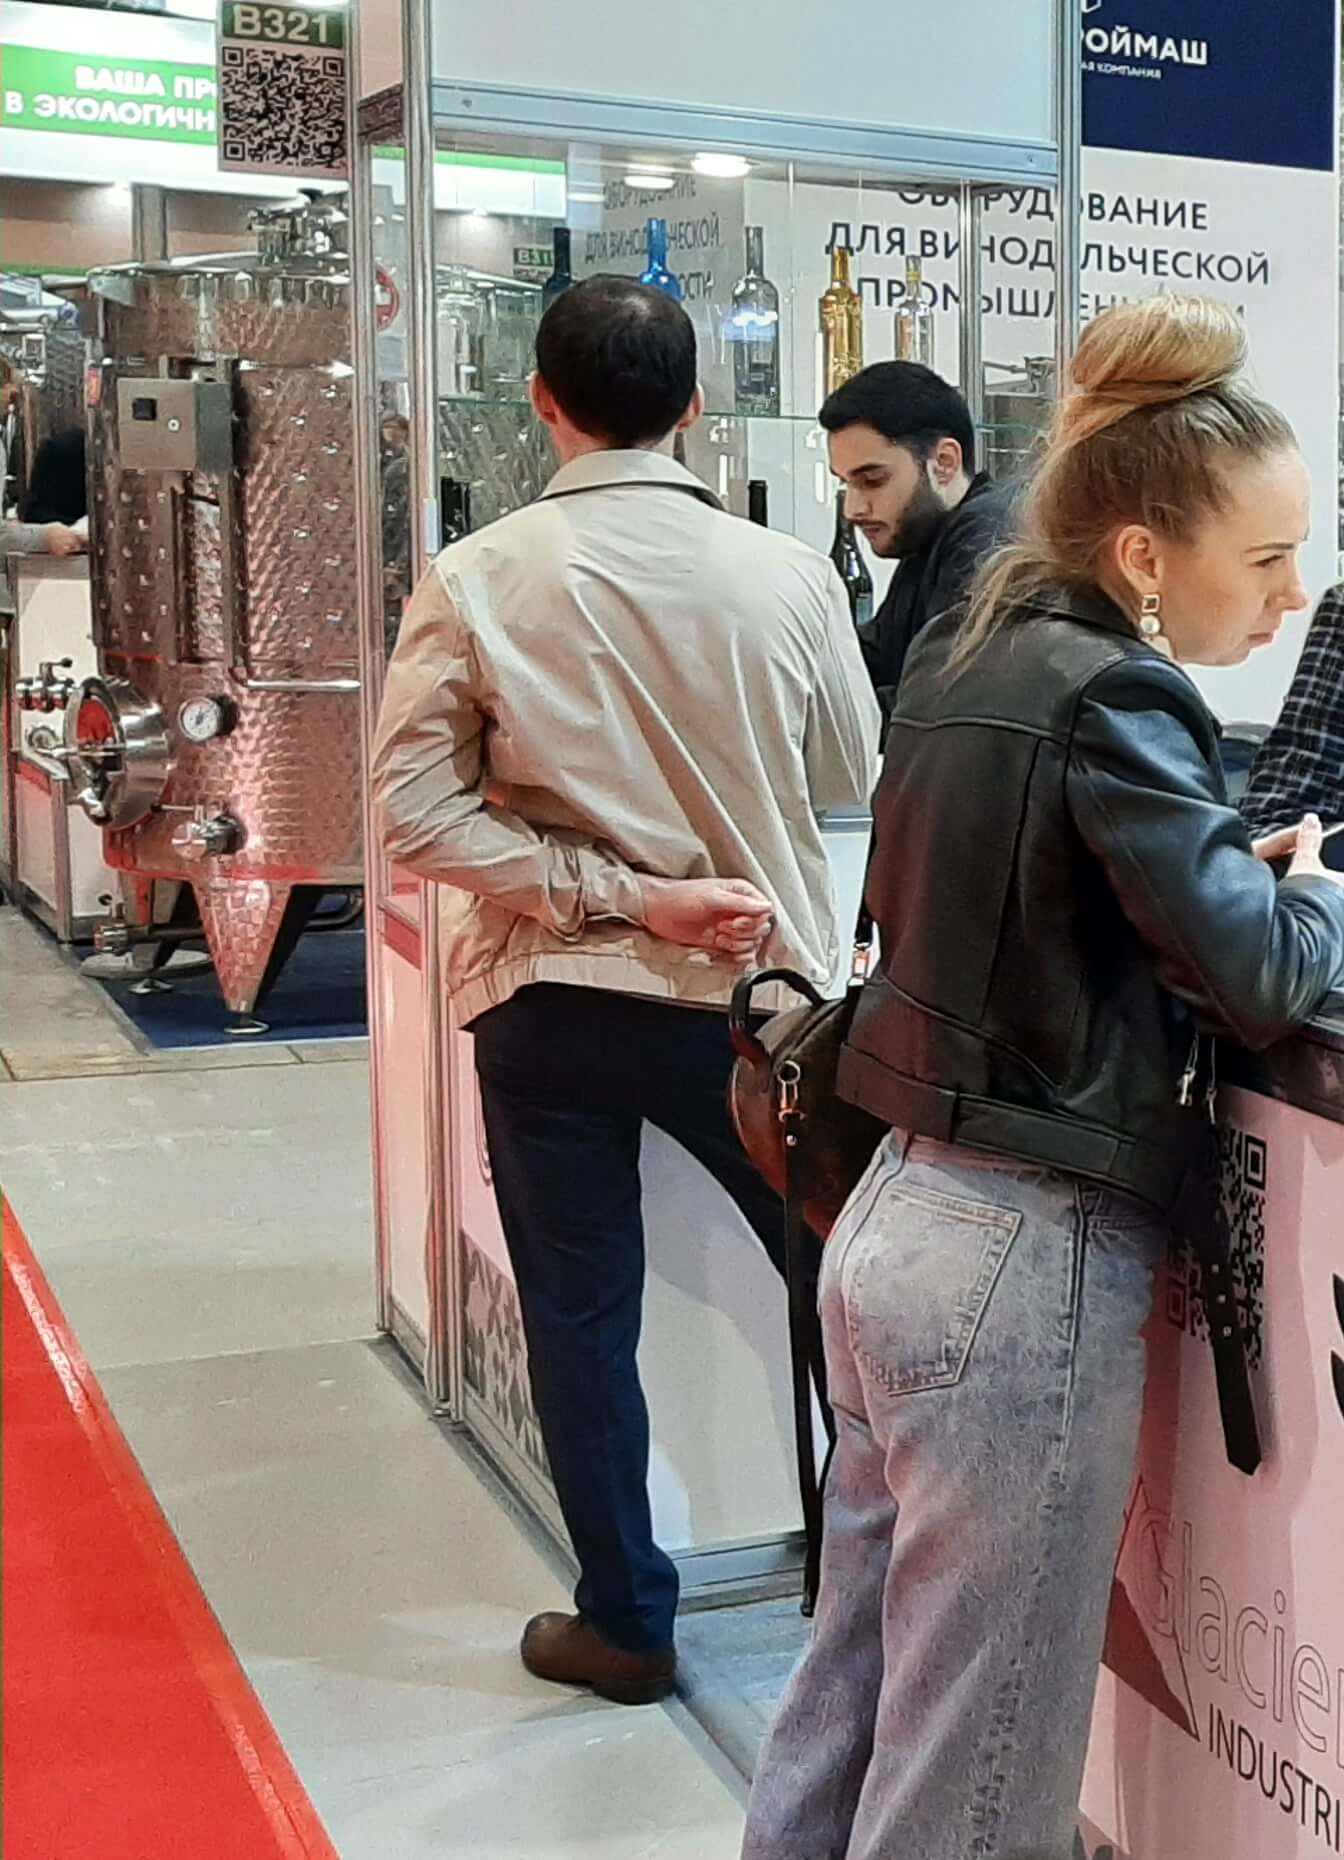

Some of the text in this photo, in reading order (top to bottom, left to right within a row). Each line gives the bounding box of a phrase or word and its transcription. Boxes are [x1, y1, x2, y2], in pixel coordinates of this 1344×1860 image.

[233, 5, 330, 42] B321
[1081, 25, 1208, 66] ОЙМАШ
[75, 65, 216, 99] ВАША ПР
[5, 91, 23, 114] В
[825, 222, 1269, 286] ДЛЯ ВИНОДЛЬЧЕСКОЙ
